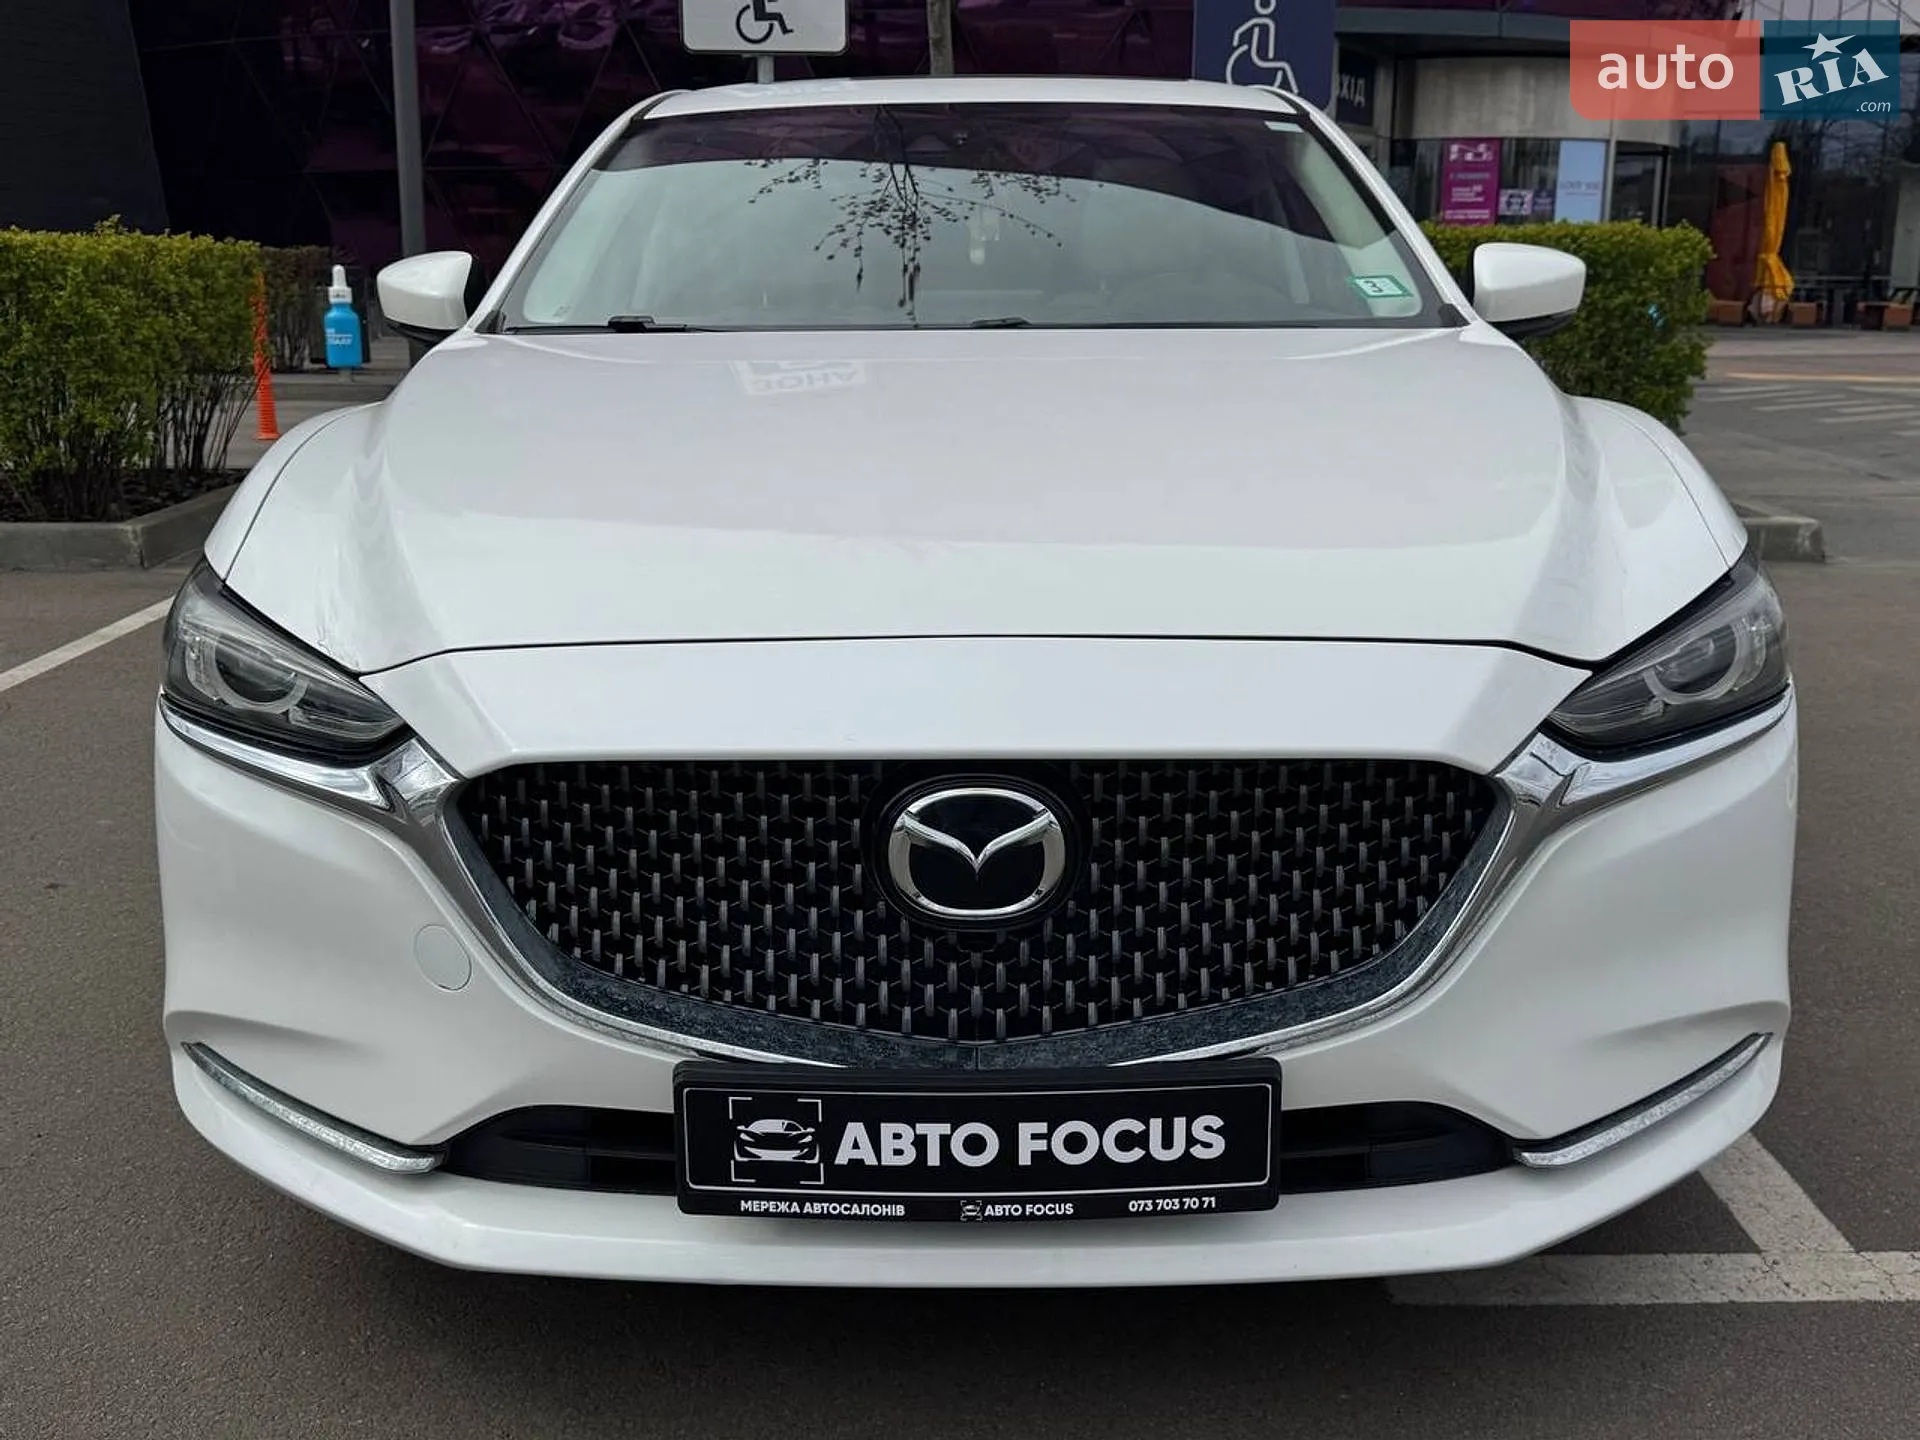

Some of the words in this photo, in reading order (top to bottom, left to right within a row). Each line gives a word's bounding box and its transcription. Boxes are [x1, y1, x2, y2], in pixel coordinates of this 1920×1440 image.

[1339, 73, 1366, 108] ХІД
[833, 1121, 1000, 1168] АВТО
[1018, 1114, 1226, 1166] FOCUS
[740, 1200, 801, 1214] МЕРЕЖА
[803, 1202, 905, 1217] АВТОСАЛОНІВ
[984, 1204, 1023, 1217] АВТО
[1025, 1203, 1074, 1215] FOCUS
[1128, 1200, 1153, 1213] 073
[1156, 1199, 1180, 1211] 703
[1182, 1198, 1200, 1210] 70
[1202, 1197, 1217, 1209] 71
